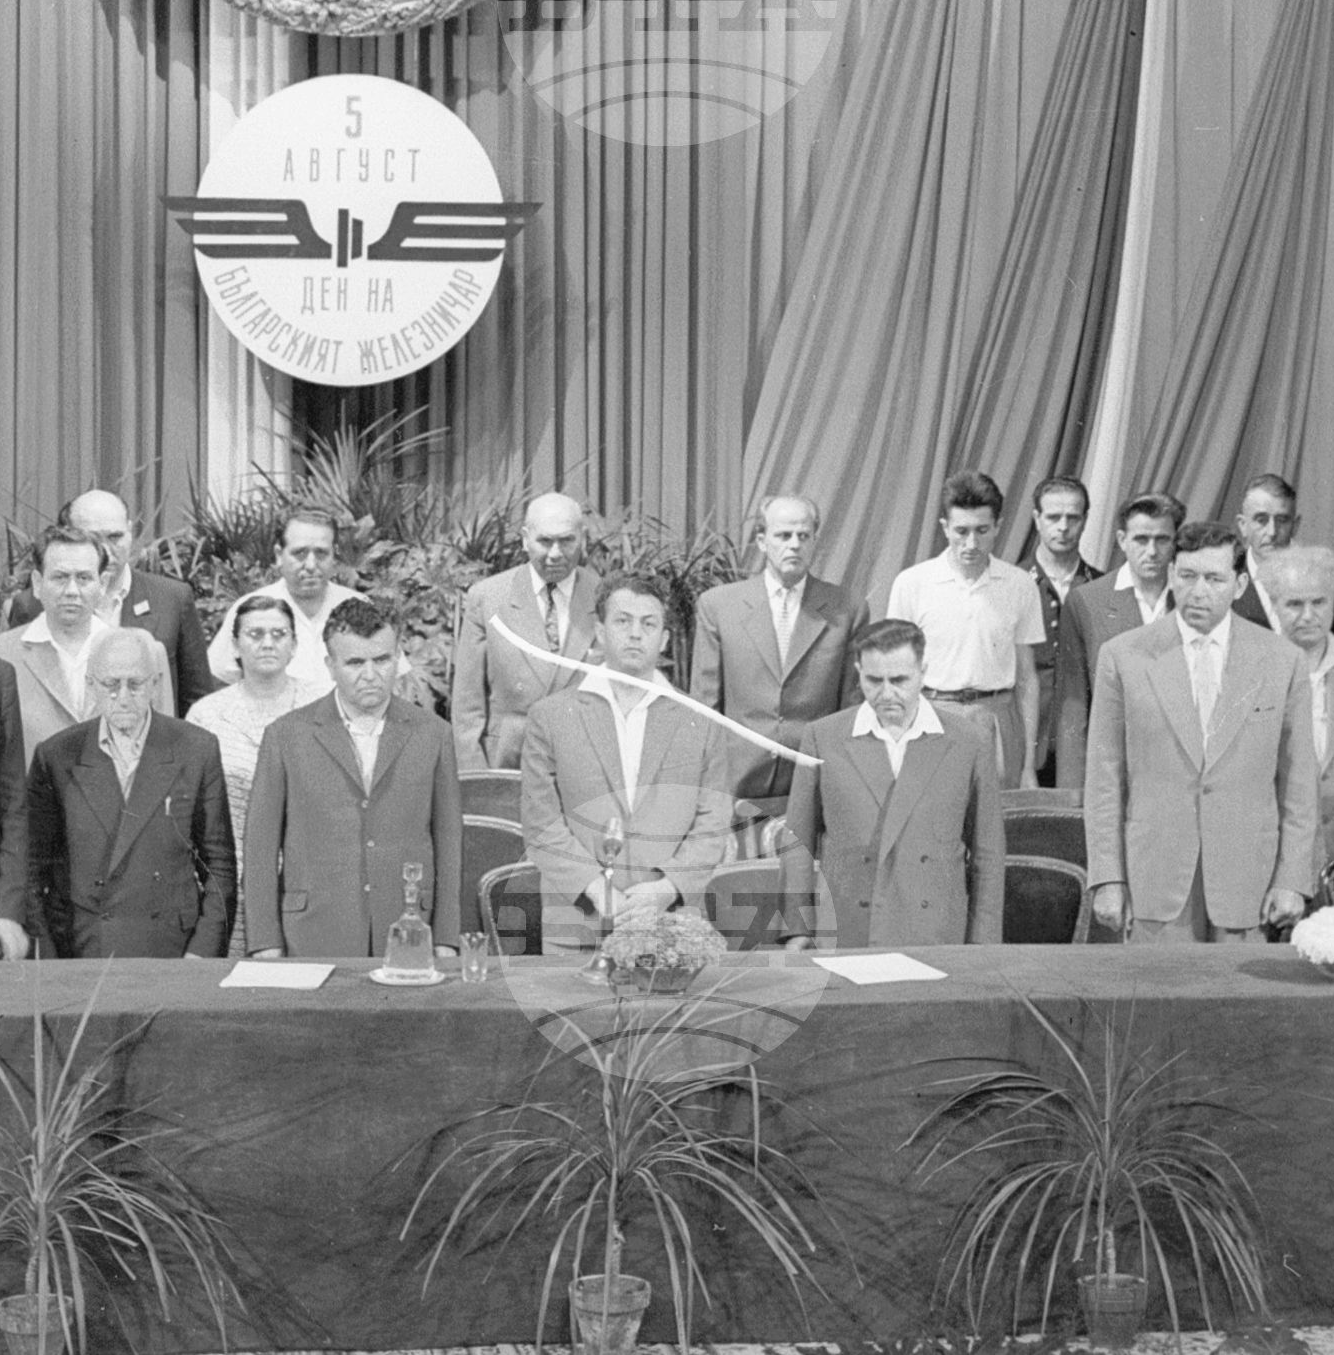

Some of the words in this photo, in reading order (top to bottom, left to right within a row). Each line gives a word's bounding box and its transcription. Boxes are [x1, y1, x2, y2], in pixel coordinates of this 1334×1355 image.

[344, 95, 363, 139] 5
[282, 147, 421, 183] АВГУСТ
[300, 276, 348, 315] ДЕН
[367, 277, 394, 313] НА
[214, 265, 344, 374] БЪЛГАРСКИЯТ
[357, 268, 483, 374] ЖЕЛЕЗНИЧАР
